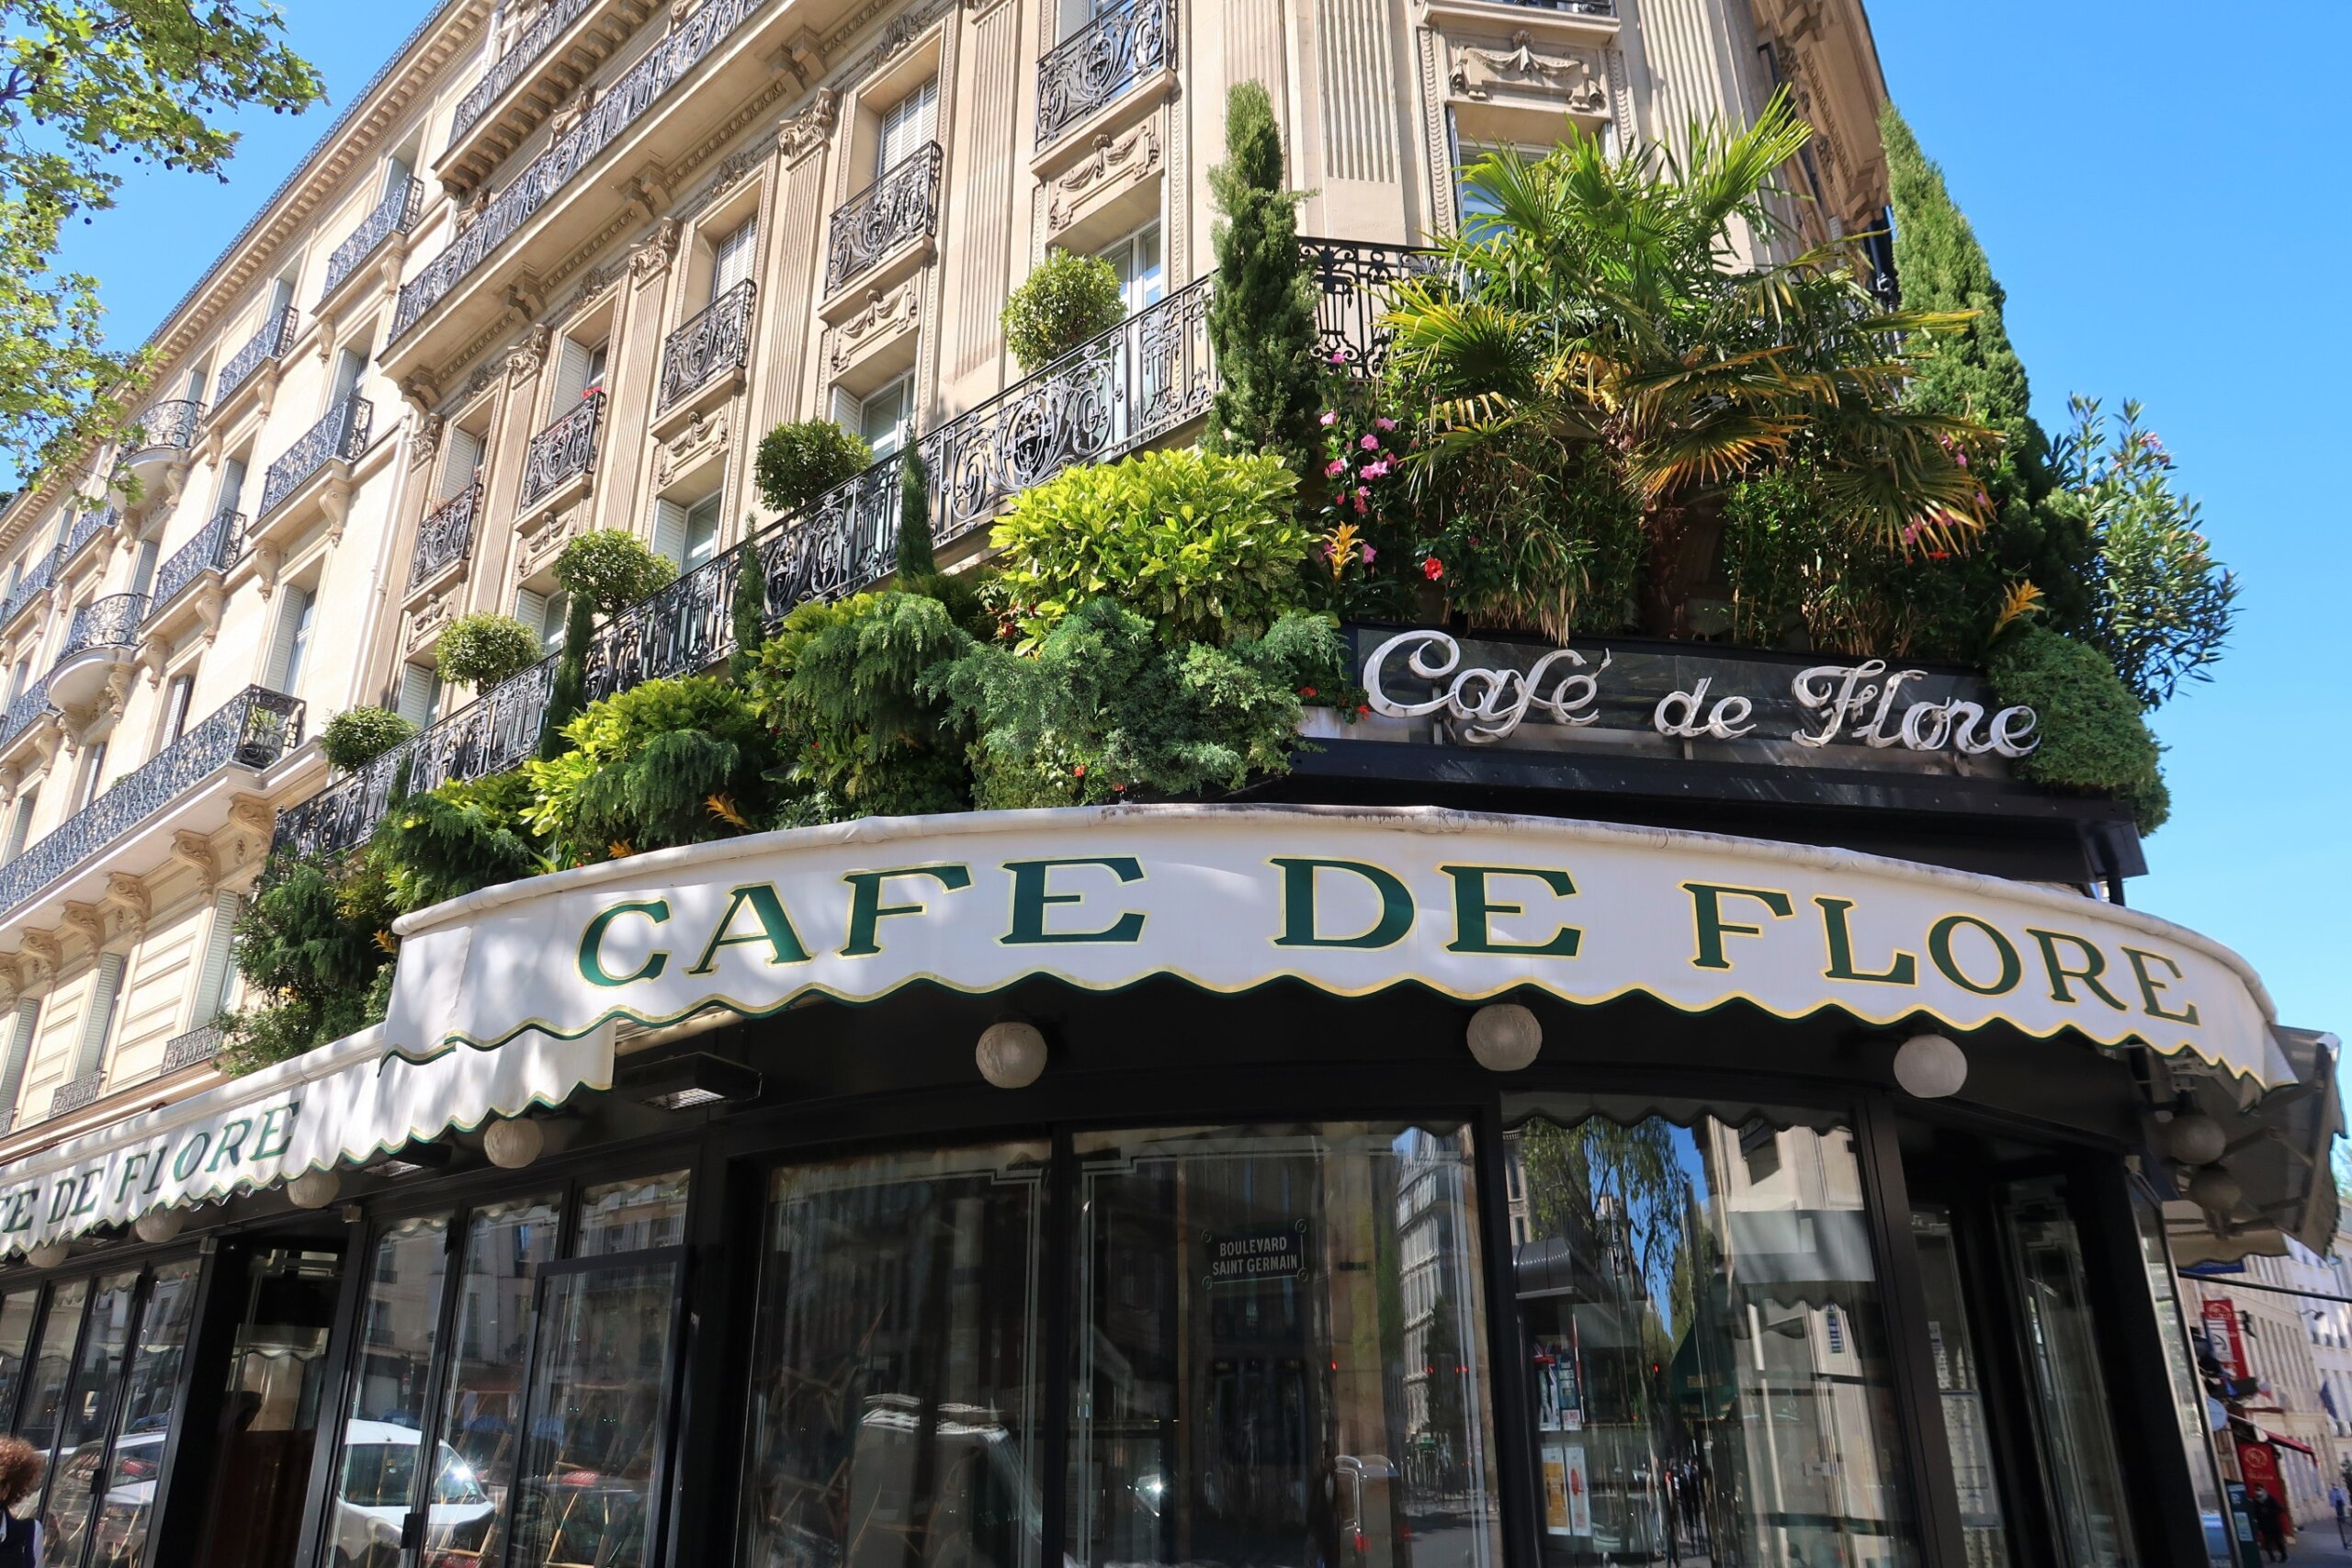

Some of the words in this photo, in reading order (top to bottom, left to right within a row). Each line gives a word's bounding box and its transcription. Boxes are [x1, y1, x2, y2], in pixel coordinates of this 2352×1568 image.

[1362, 628, 1614, 745] Café
[1655, 676, 1758, 739] de
[1791, 659, 2041, 759] Flore
[574, 853, 1149, 988] CAFE
[1261, 854, 1587, 960] DE
[1676, 879, 2202, 1027] FLORE
[47, 1168, 105, 1225] DE
[115, 1101, 300, 1204] FLORE
[1213, 1258, 1244, 1276] SAINT
[1246, 1254, 1297, 1273] GERMAIN
[1219, 1235, 1287, 1258] BOULEVARD
